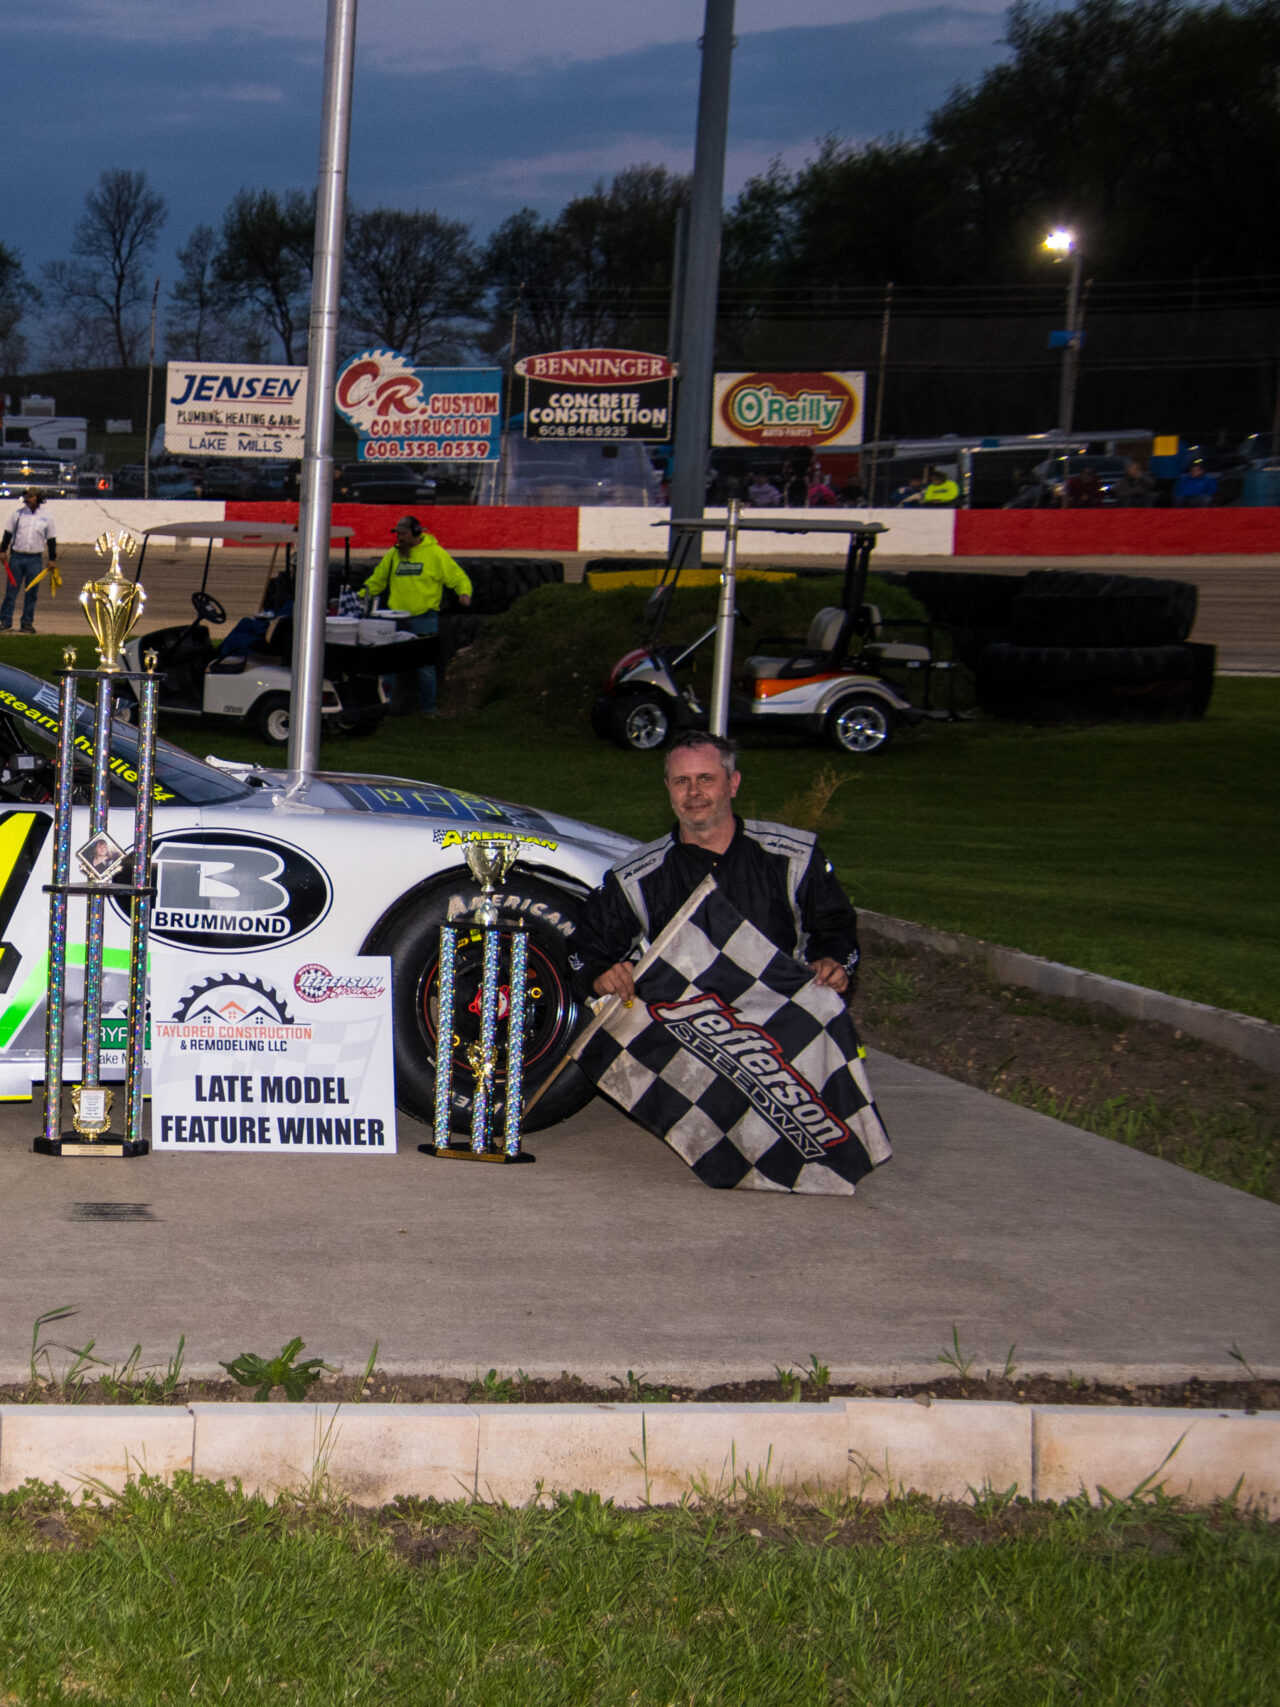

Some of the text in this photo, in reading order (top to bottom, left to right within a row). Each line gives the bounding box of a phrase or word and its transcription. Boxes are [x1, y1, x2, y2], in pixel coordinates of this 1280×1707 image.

[534, 358, 664, 377] BENNINGER
[170, 374, 302, 405] JENSEN
[338, 360, 428, 417] C.R.
[430, 394, 498, 414] CUSTOM
[549, 393, 640, 408] CONCRETE
[737, 391, 838, 426] O'Reilly
[226, 412, 265, 425] HEATING
[268, 414, 276, 425] &
[529, 408, 667, 424] CONSTRUCTION
[371, 418, 492, 436] CONSTRUCTION
[189, 437, 283, 452] LAKE MILLS
[365, 441, 489, 458] 608.358.0539
[153, 842, 290, 912] B
[155, 911, 286, 934] BRUMMOND
[296, 975, 383, 988] JEFFERSON
[156, 1025, 312, 1039] TAYLORED CONSTRUCTION
[180, 1040, 288, 1052] & REMODELING LLC
[99, 1053, 119, 1065] ake
[650, 995, 846, 1144] Jefferson
[195, 1075, 350, 1104] LATE MODEL
[672, 1023, 819, 1154] SPEEDWAY
[161, 1115, 385, 1146] FEATURE WINNER
